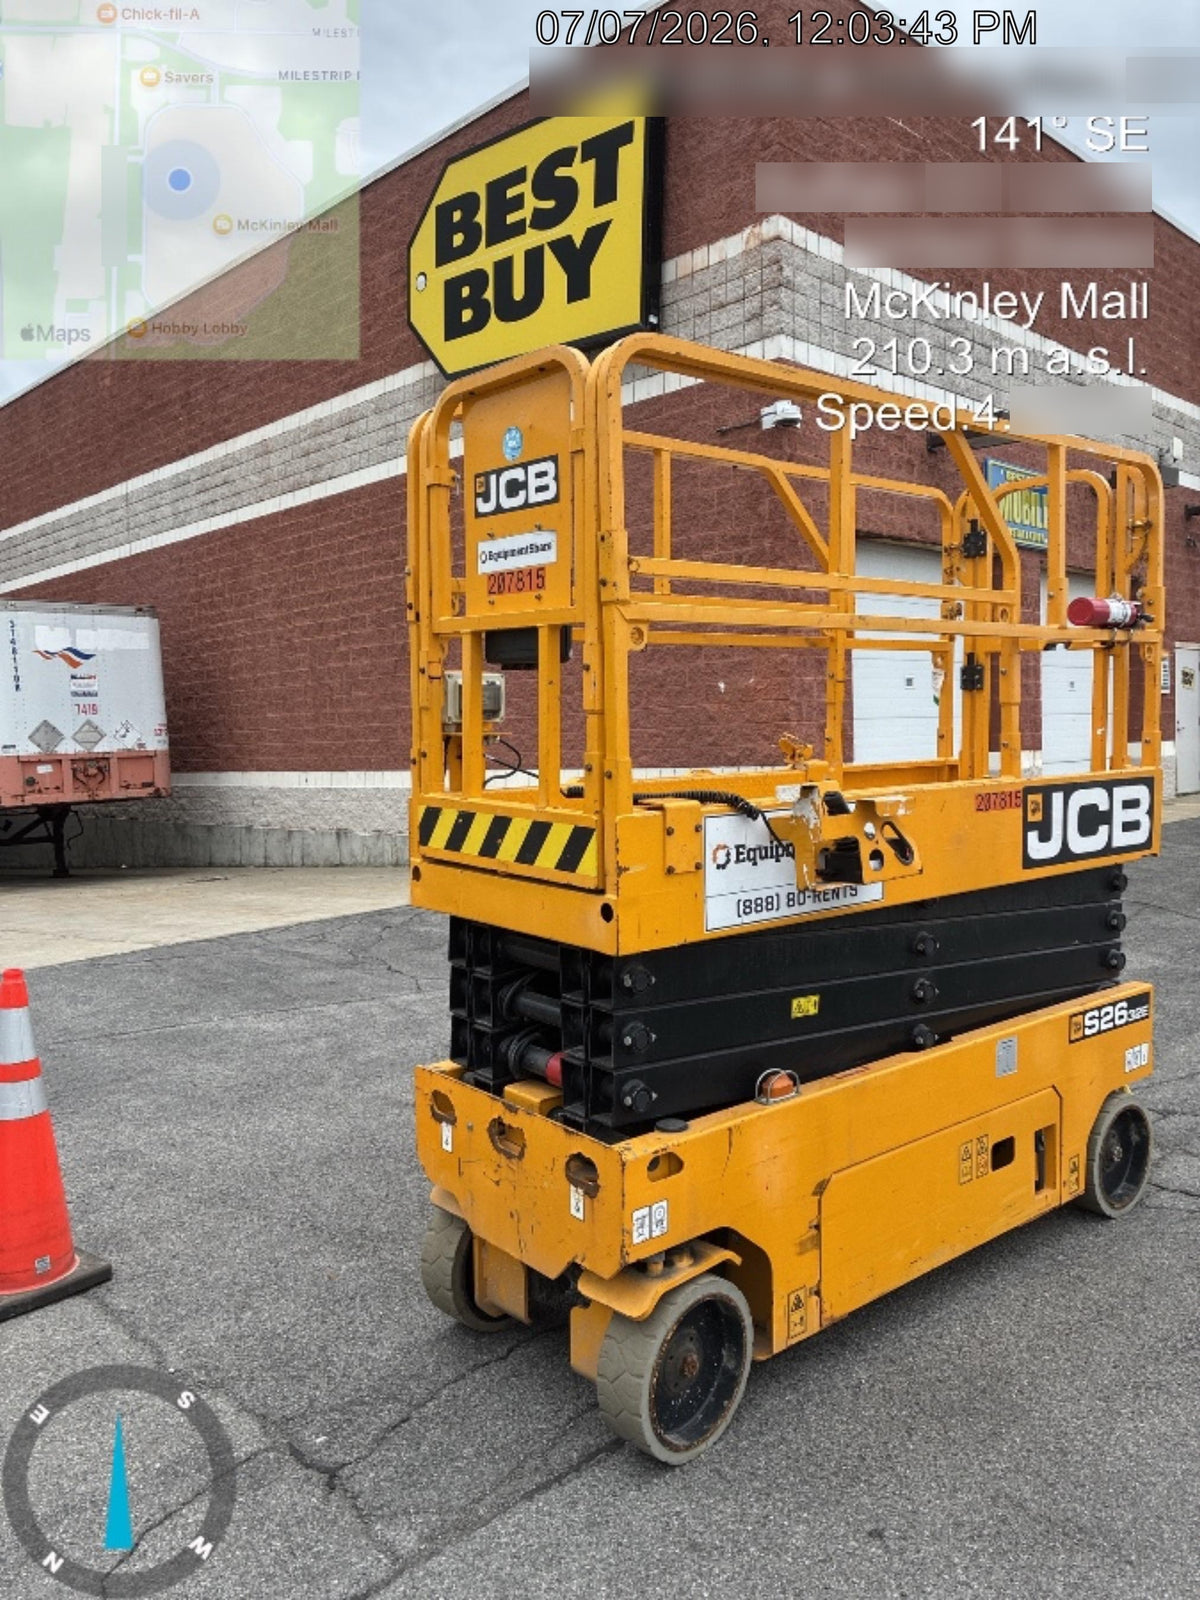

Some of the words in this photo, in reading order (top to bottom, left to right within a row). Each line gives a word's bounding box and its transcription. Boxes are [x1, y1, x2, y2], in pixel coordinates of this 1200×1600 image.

[435, 120, 635, 268] BEST
[444, 219, 613, 342] BUY
[476, 461, 559, 513] JCB
[1027, 784, 1151, 860] JCB
